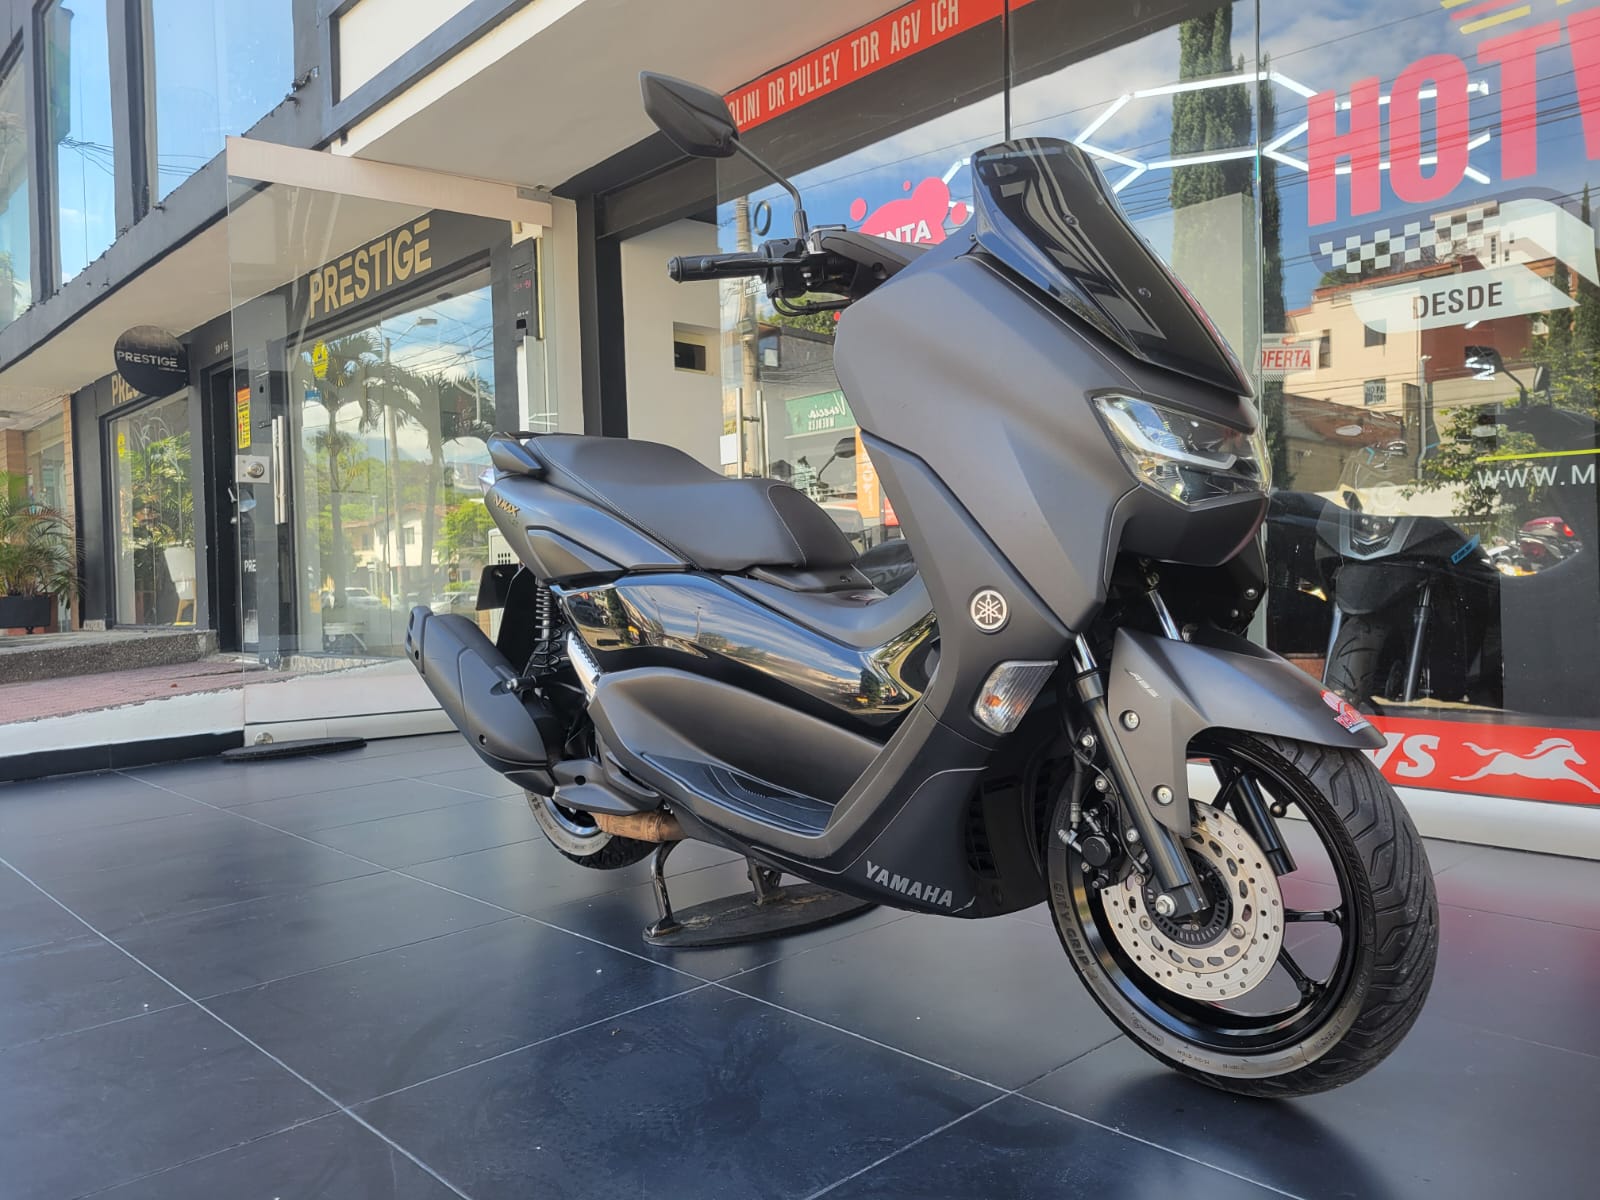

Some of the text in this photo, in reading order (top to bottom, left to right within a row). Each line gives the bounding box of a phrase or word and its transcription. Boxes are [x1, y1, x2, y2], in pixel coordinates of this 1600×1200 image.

[768, 77, 785, 111] DR
[790, 49, 840, 101] PULLEY
[851, 30, 880, 71] TDR
[890, 9, 921, 54] AGV
[931, 0, 959, 35] ICH
[309, 217, 432, 320] PRESTIGE
[1413, 281, 1503, 319] DESDE
[116, 351, 179, 368] PRESTIGE
[866, 860, 953, 908] YAMAHA
[1065, 926, 1091, 967] GRIP
